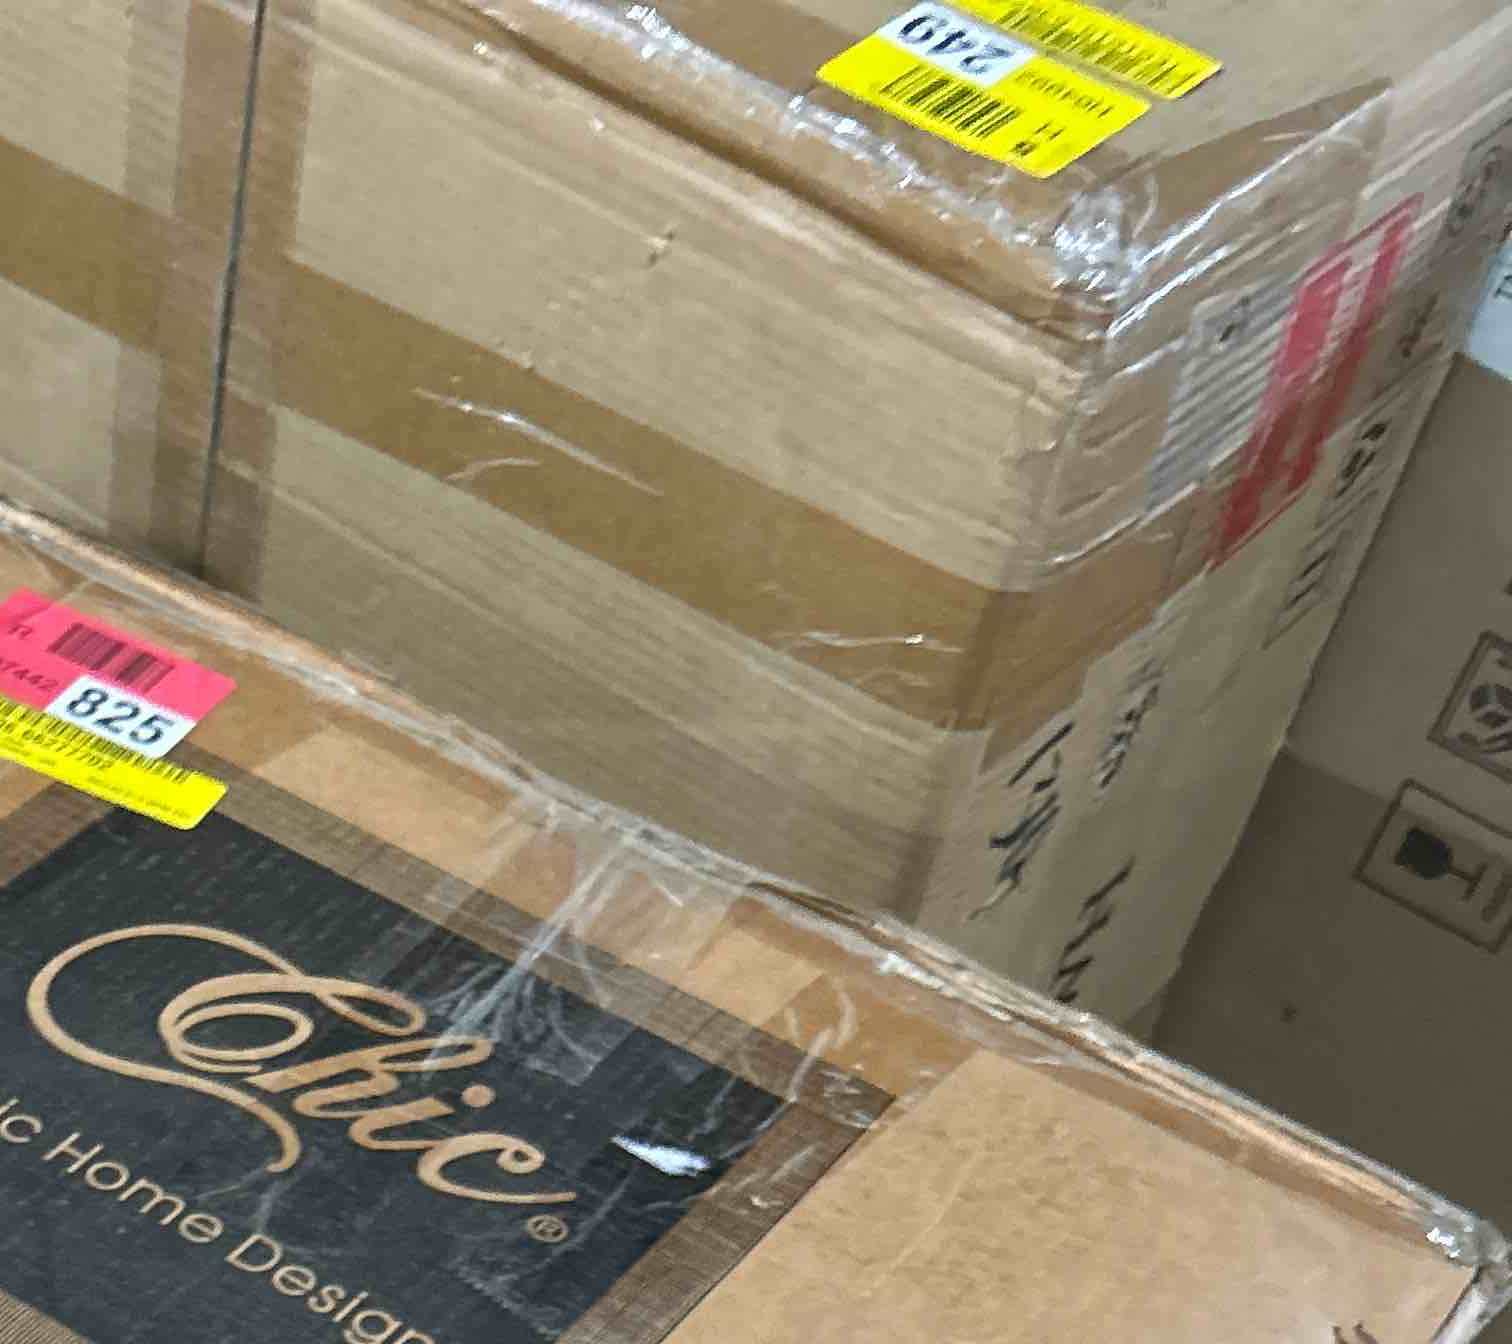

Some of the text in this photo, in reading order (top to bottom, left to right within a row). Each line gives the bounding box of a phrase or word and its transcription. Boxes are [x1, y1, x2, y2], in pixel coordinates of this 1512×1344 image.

[897, 13, 1015, 75] 249
[65, 687, 176, 747] 825
[25, 922, 578, 1204] Chic
[42, 1131, 224, 1245] Home
